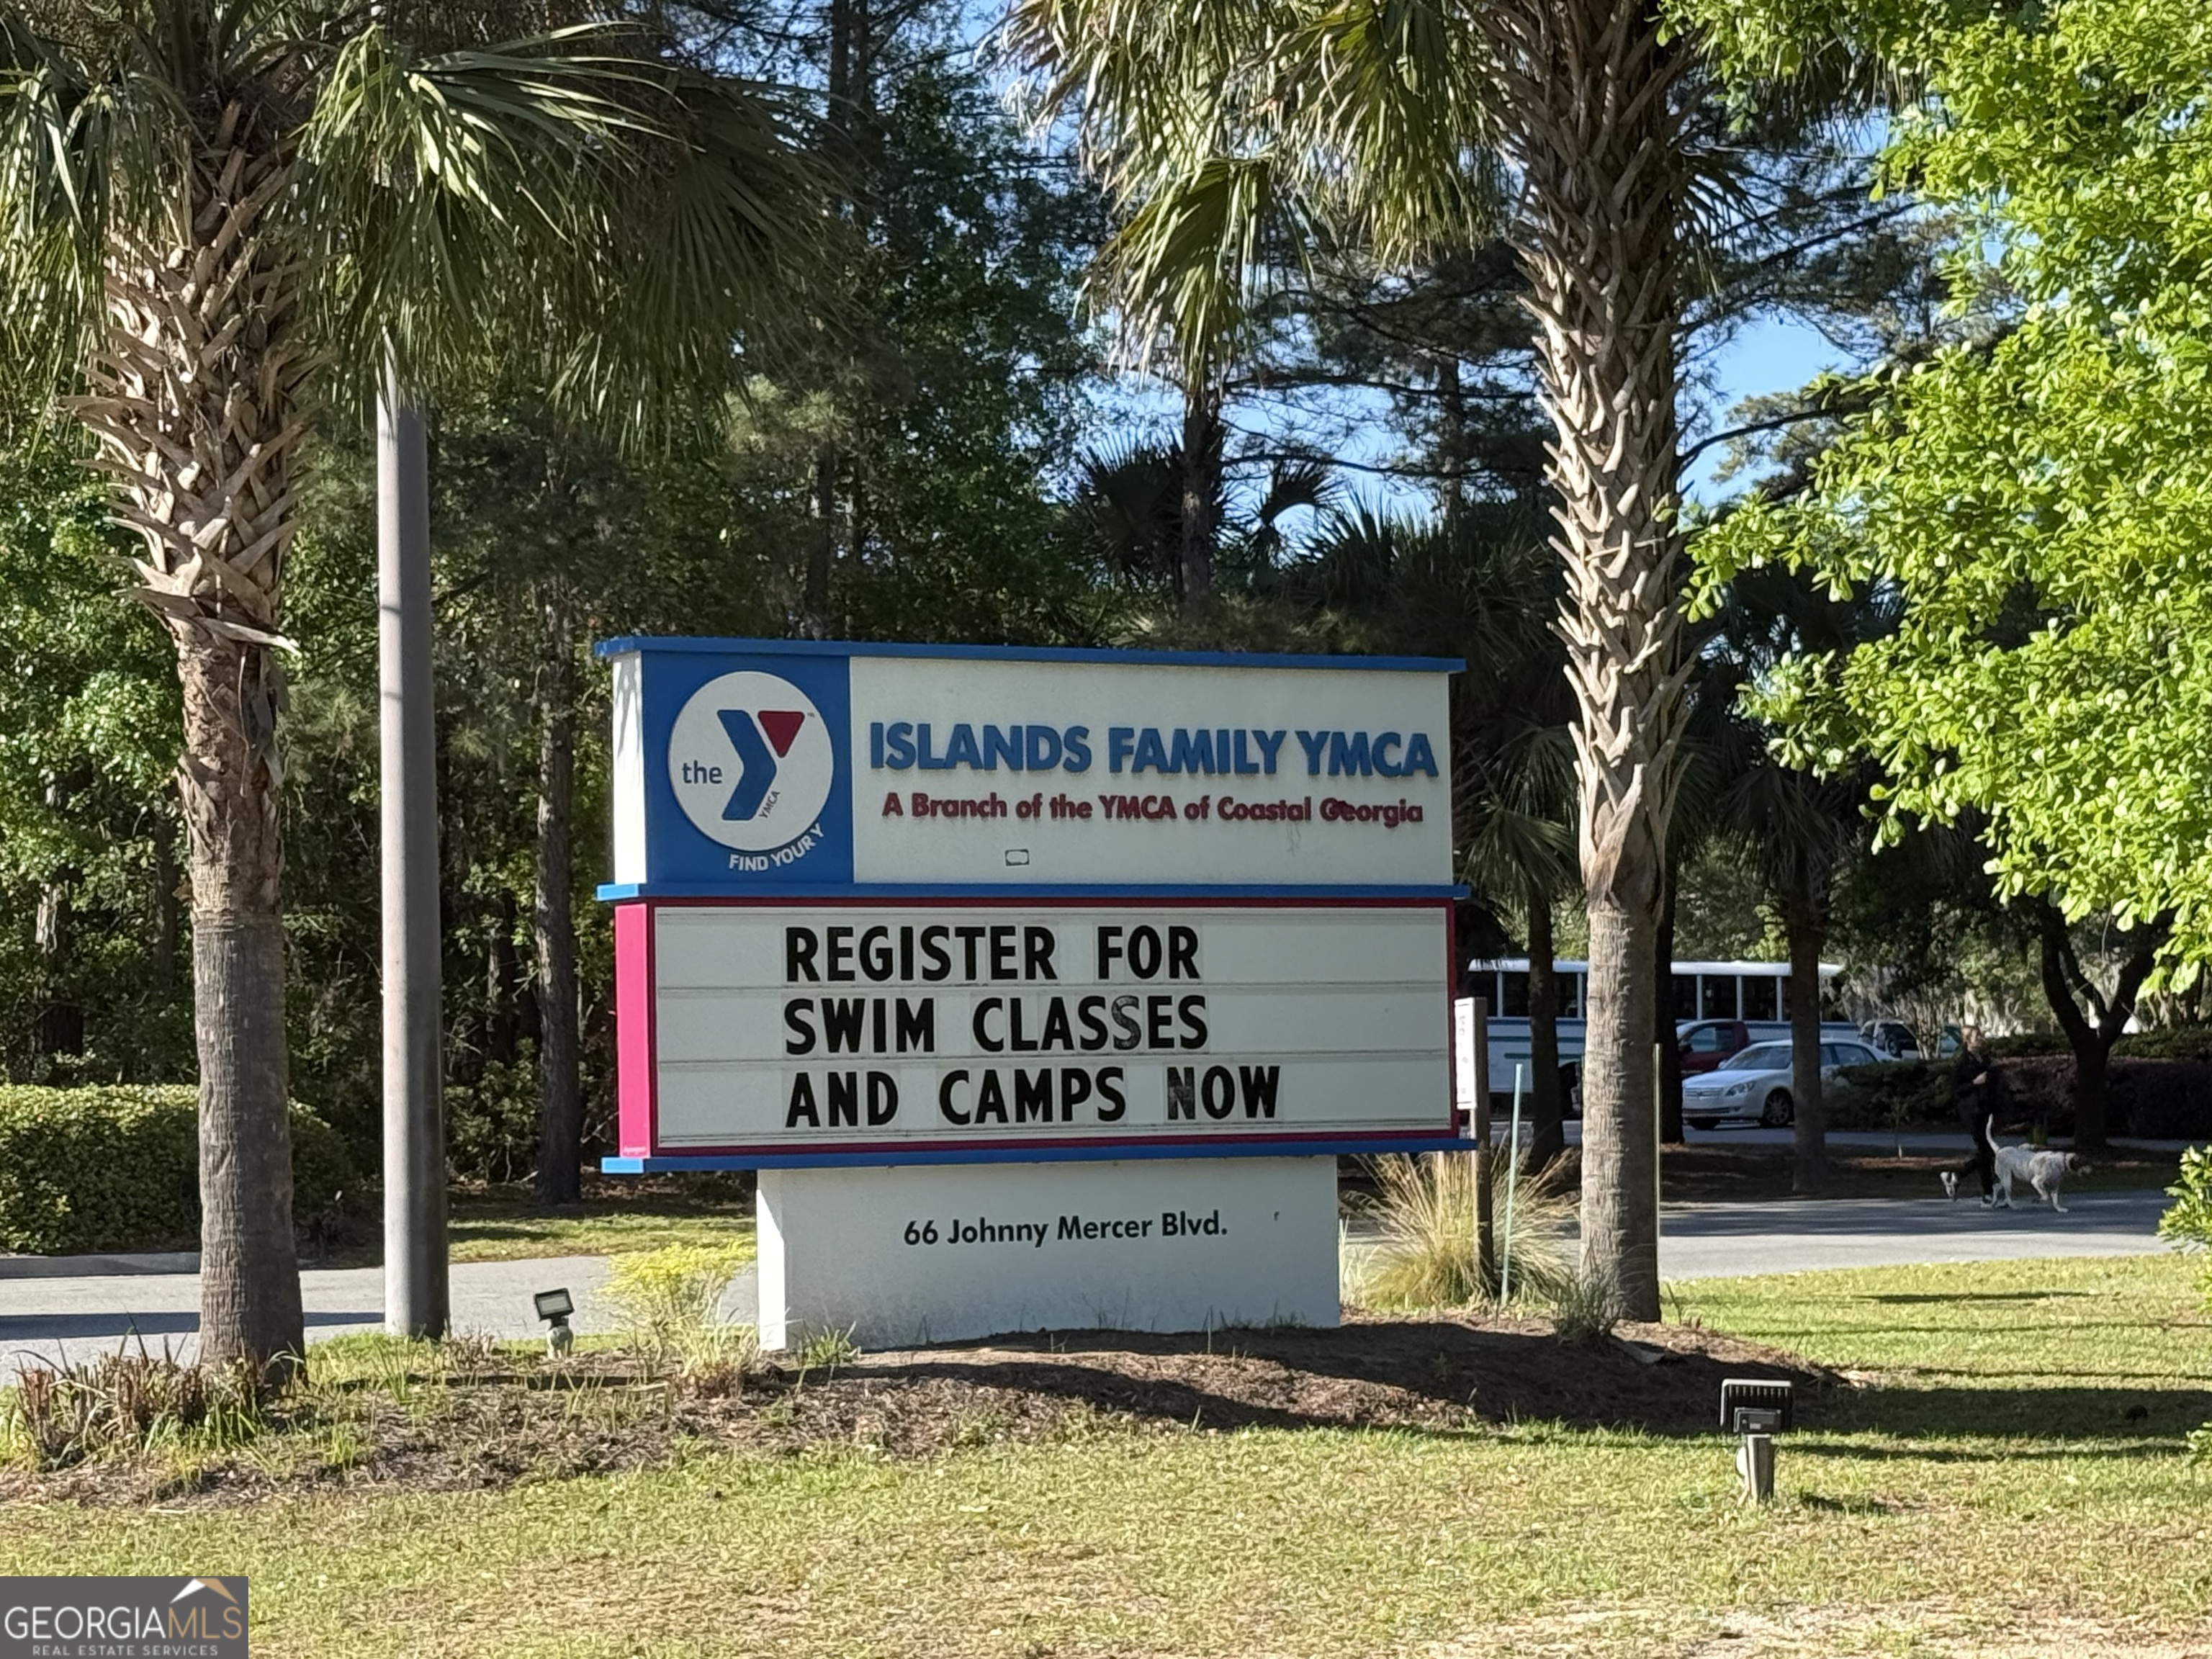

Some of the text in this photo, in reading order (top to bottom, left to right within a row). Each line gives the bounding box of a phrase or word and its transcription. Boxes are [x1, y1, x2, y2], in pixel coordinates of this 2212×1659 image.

[682, 760, 722, 784] the
[871, 722, 1439, 778] ISLANDS FAMILY YMCA
[759, 790, 781, 819] YMCA
[882, 792, 1423, 828] A Branch of the YMCA of Coastal Georgia
[729, 823, 824, 871] FIND YOUR Y
[786, 925, 1200, 982] REGISTER FOR
[784, 995, 1208, 1055] SWIM CLASSES
[786, 1066, 1281, 1128] AND CAMPS NOW
[903, 1210, 1228, 1248] 66 Johnny Mercer Blvd.
